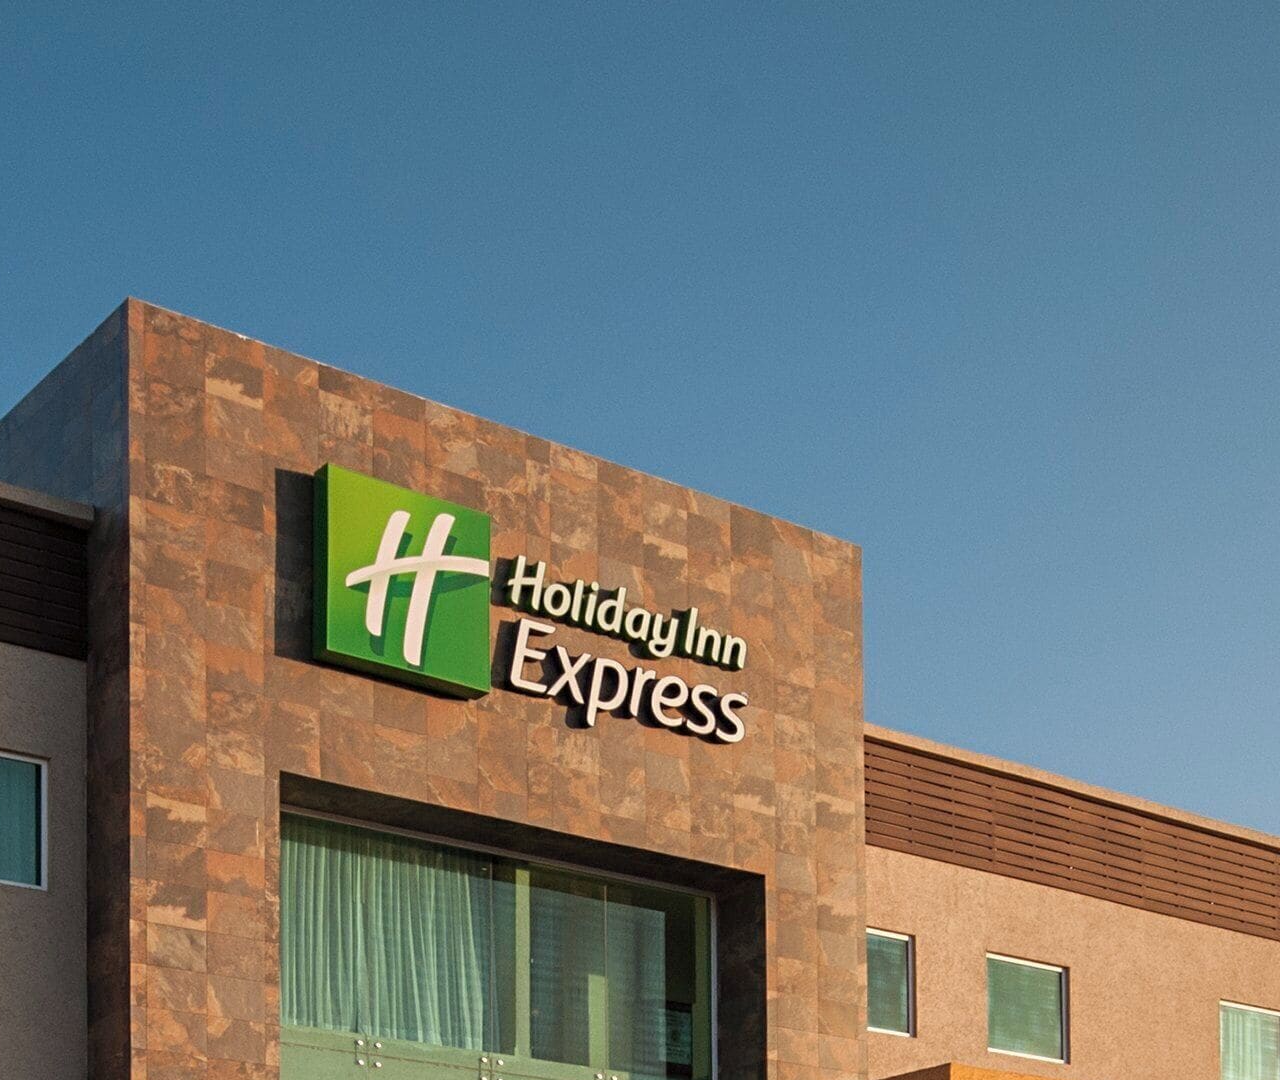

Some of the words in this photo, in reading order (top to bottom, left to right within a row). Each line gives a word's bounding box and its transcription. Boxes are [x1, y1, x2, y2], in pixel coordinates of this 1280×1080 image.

[507, 555, 679, 658] Holiday
[684, 607, 747, 669] Inn
[510, 618, 748, 743] Express
